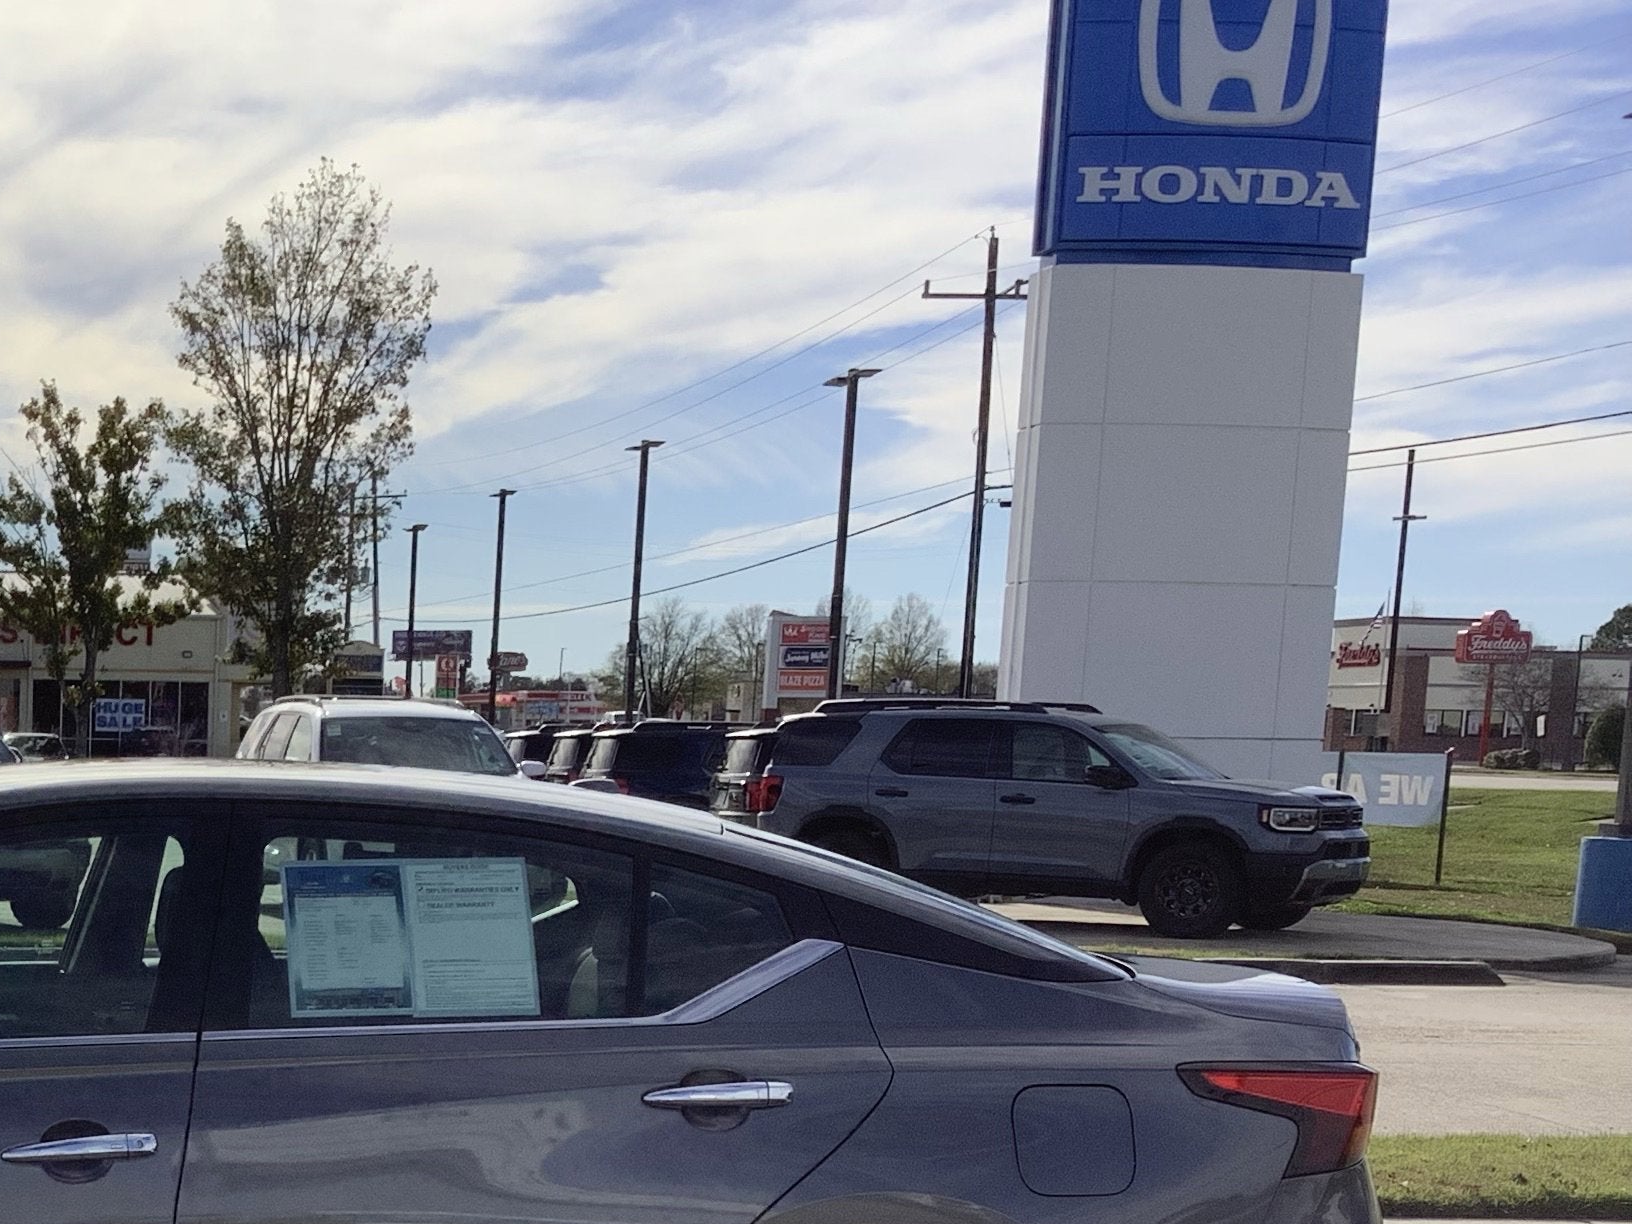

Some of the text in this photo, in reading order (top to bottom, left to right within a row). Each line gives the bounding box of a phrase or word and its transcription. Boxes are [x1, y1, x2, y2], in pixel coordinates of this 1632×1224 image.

[1075, 165, 1361, 210] HONDA
[1468, 634, 1528, 653] Freddy's
[97, 702, 143, 714] HUGE
[96, 716, 144, 728] SALE
